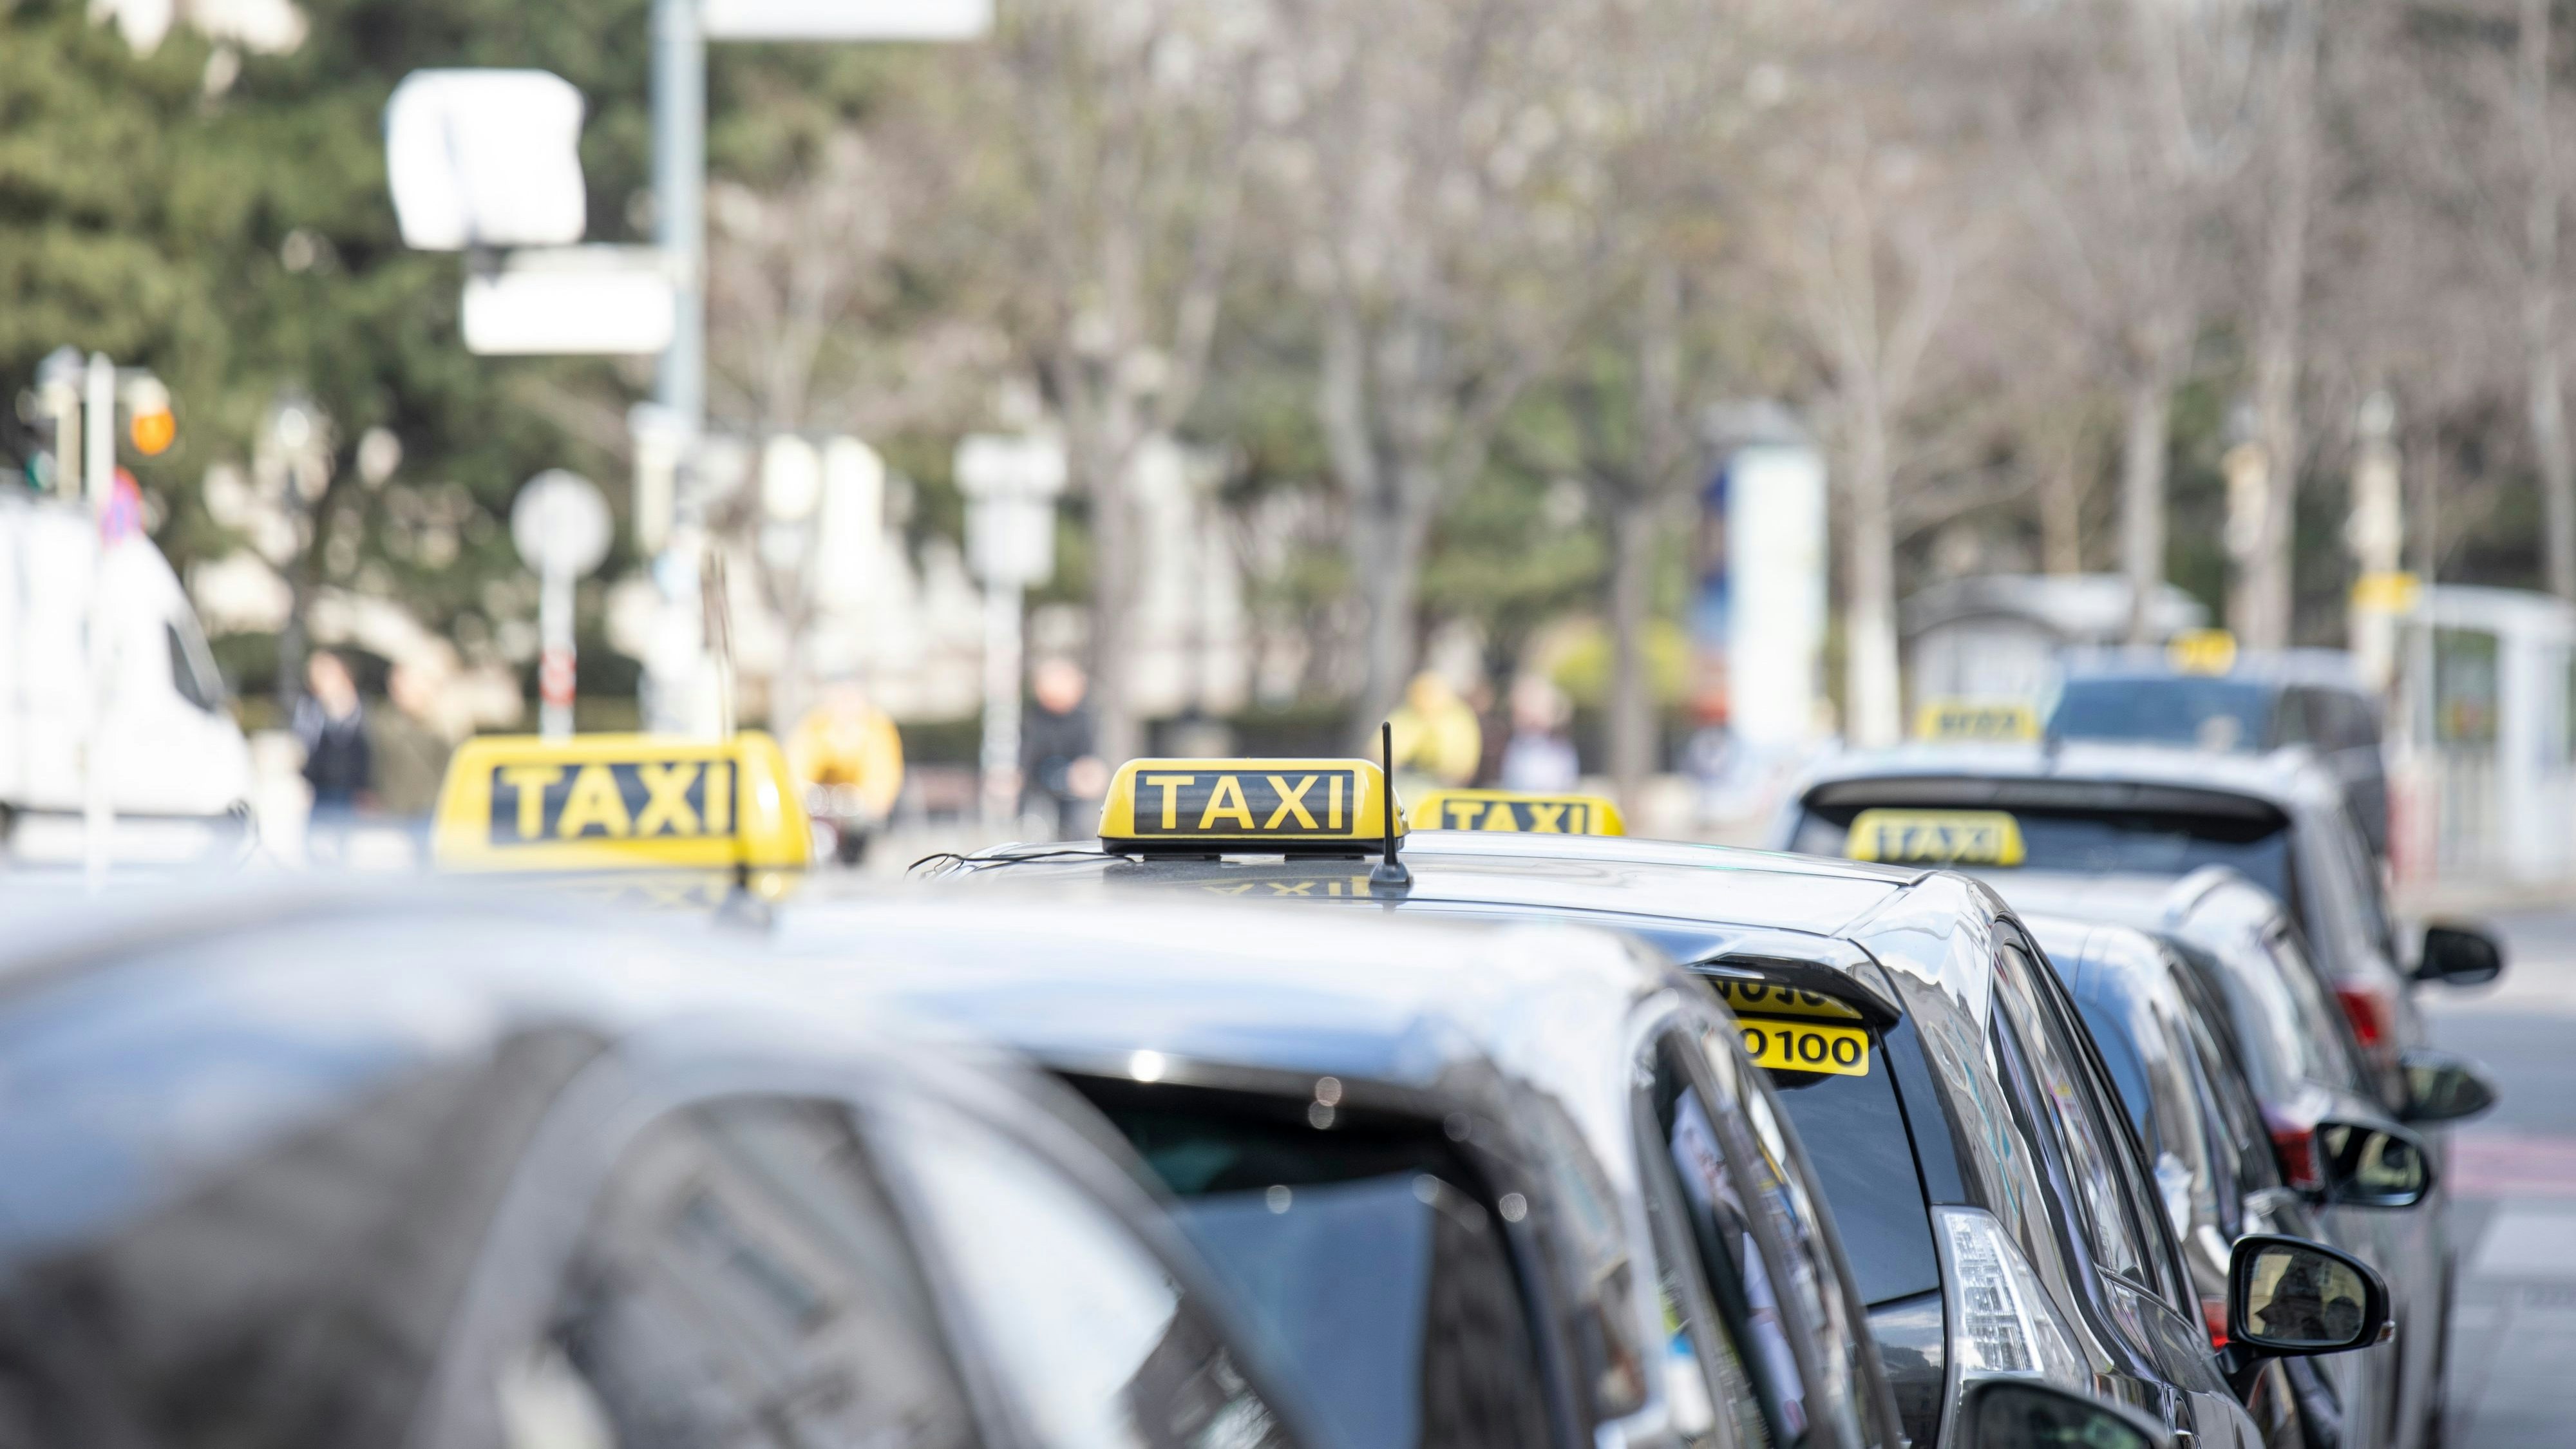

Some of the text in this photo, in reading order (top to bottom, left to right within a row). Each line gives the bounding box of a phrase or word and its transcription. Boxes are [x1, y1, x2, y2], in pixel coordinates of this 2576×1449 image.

[501, 764, 729, 838] TAXI
[1146, 775, 1343, 829] TAXI
[1446, 802, 1584, 835] TAXI
